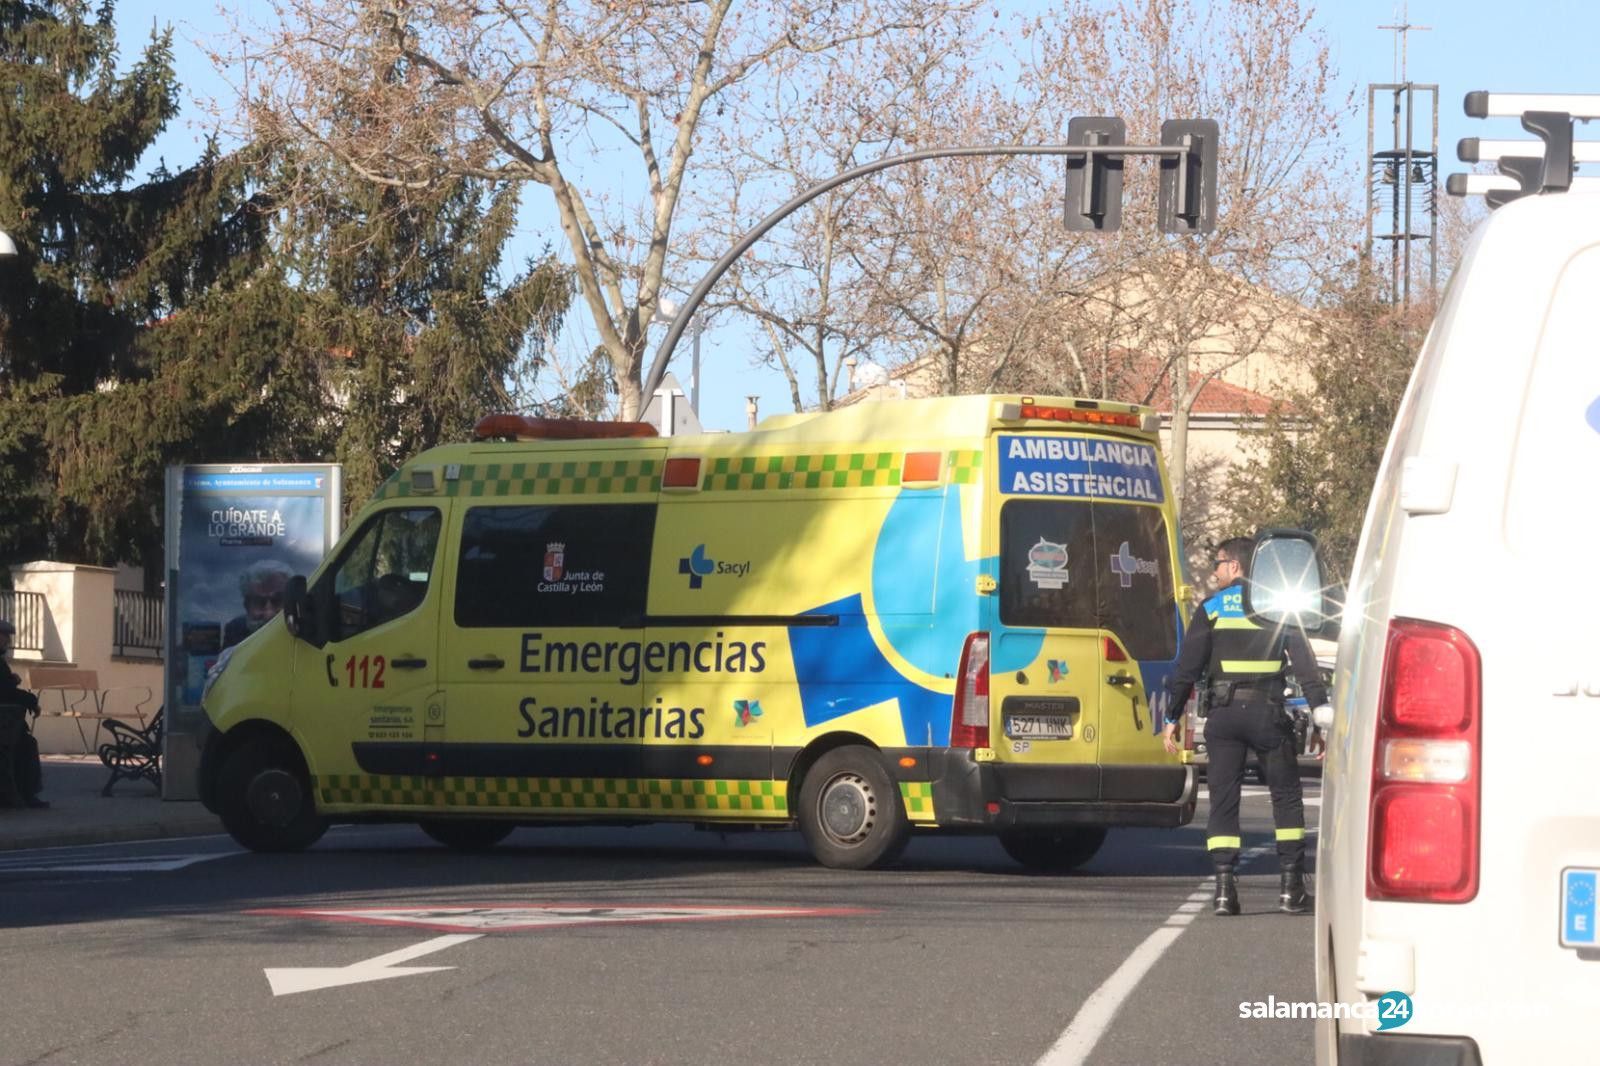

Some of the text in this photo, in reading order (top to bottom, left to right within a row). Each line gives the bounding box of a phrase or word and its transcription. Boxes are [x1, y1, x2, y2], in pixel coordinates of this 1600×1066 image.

[1008, 438, 1153, 467] AMBULANCIA
[1012, 471, 1157, 500] ASISTENCIAL
[211, 507, 282, 524] CUÍDATE A
[208, 523, 286, 537] LO GRANDE
[564, 570, 605, 583] Junta de
[717, 560, 751, 577] Sacyl
[537, 580, 604, 595] Castilla y León
[520, 631, 766, 685] Emergencias
[345, 654, 385, 689] 112
[517, 696, 705, 739] Sanitarias
[1013, 716, 1069, 736] 5271 HNK
[1013, 741, 1030, 752] SP
[1573, 913, 1588, 932] E
